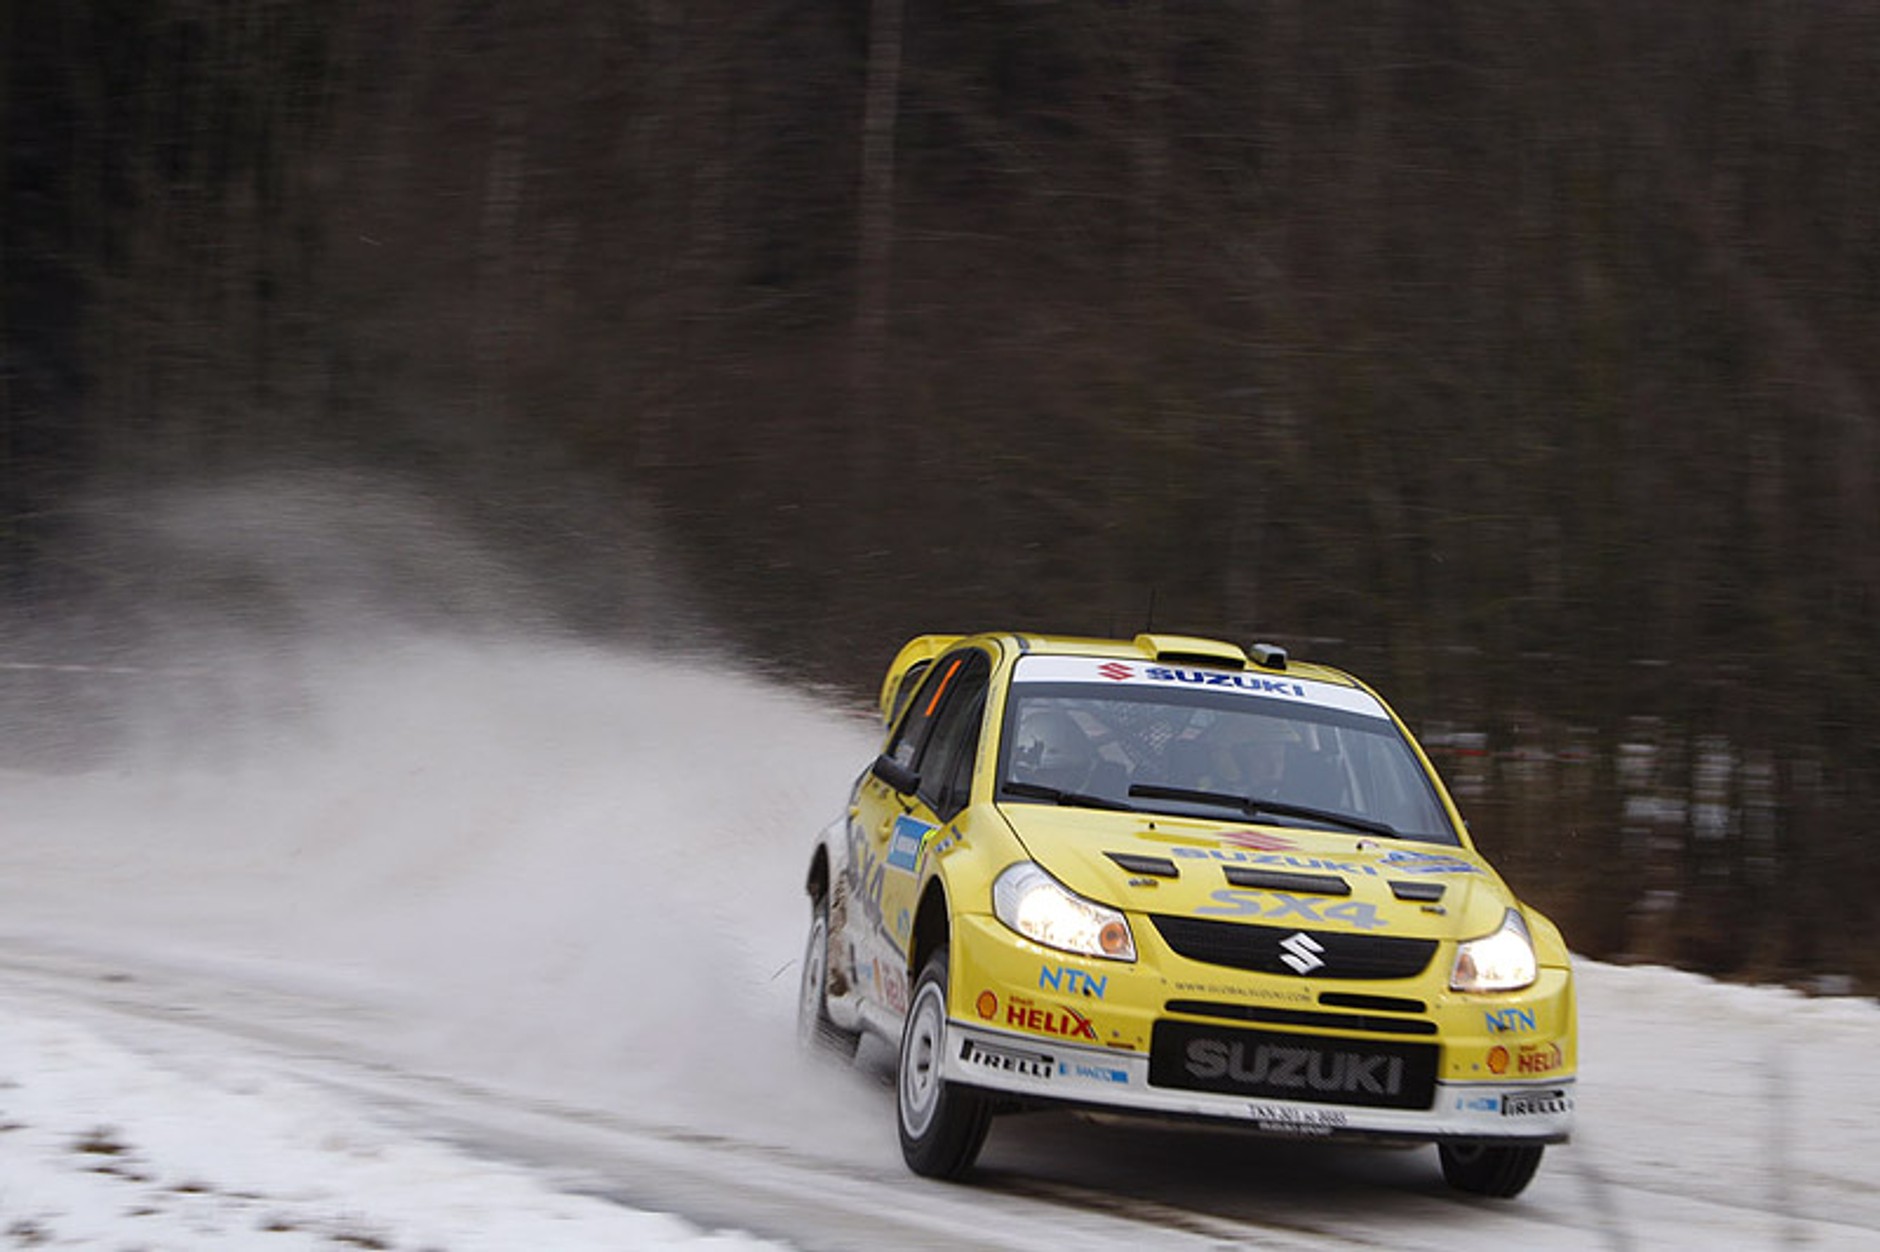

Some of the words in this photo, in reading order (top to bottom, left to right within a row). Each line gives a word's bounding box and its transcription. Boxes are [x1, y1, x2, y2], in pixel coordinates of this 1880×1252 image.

[1145, 667, 1305, 697] SUZUKI
[1171, 848, 1378, 876] SUZUKI
[1193, 889, 1389, 929] SX4
[1039, 965, 1108, 999] NTN
[1006, 1005, 1098, 1040] HELIX
[1484, 1008, 1536, 1033] NTN
[960, 1038, 1053, 1078] PIRELLI
[1185, 1038, 1404, 1095] SUZUKI
[1502, 1090, 1573, 1116] PIRELLI
